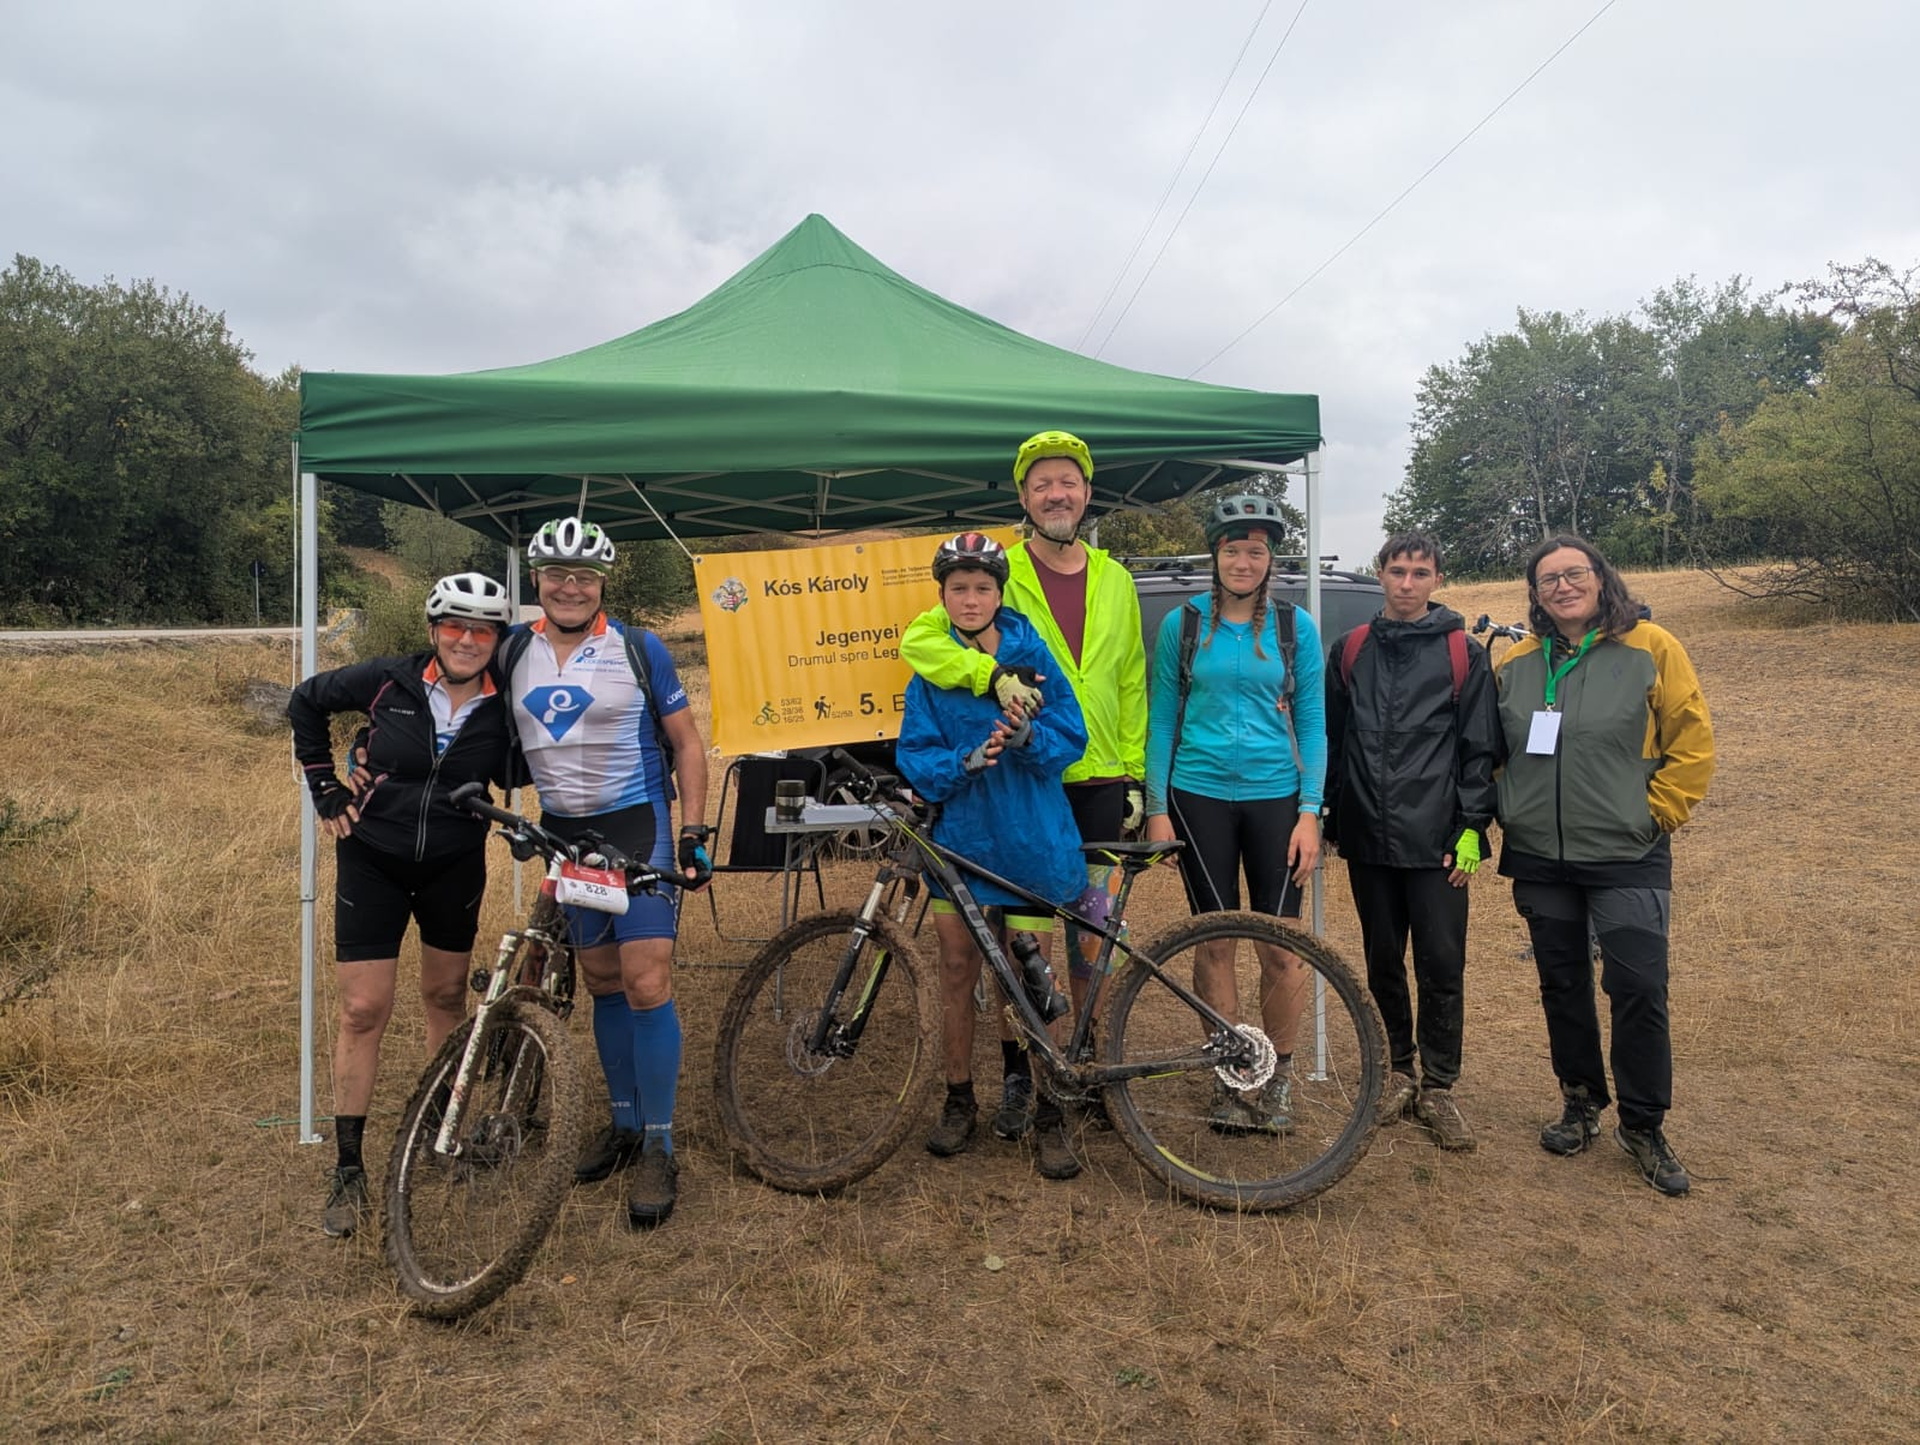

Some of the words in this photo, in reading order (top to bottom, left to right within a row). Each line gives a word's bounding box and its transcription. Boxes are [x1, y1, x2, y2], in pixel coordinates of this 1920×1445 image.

[764, 579, 802, 596] Kós
[808, 573, 869, 593] Károly
[816, 623, 899, 648] Jegenyei
[788, 652, 836, 667] Drumul
[840, 650, 869, 663] spre
[873, 647, 899, 660] Leg
[860, 693, 883, 715] 5.
[952, 883, 1012, 970] CUBE
